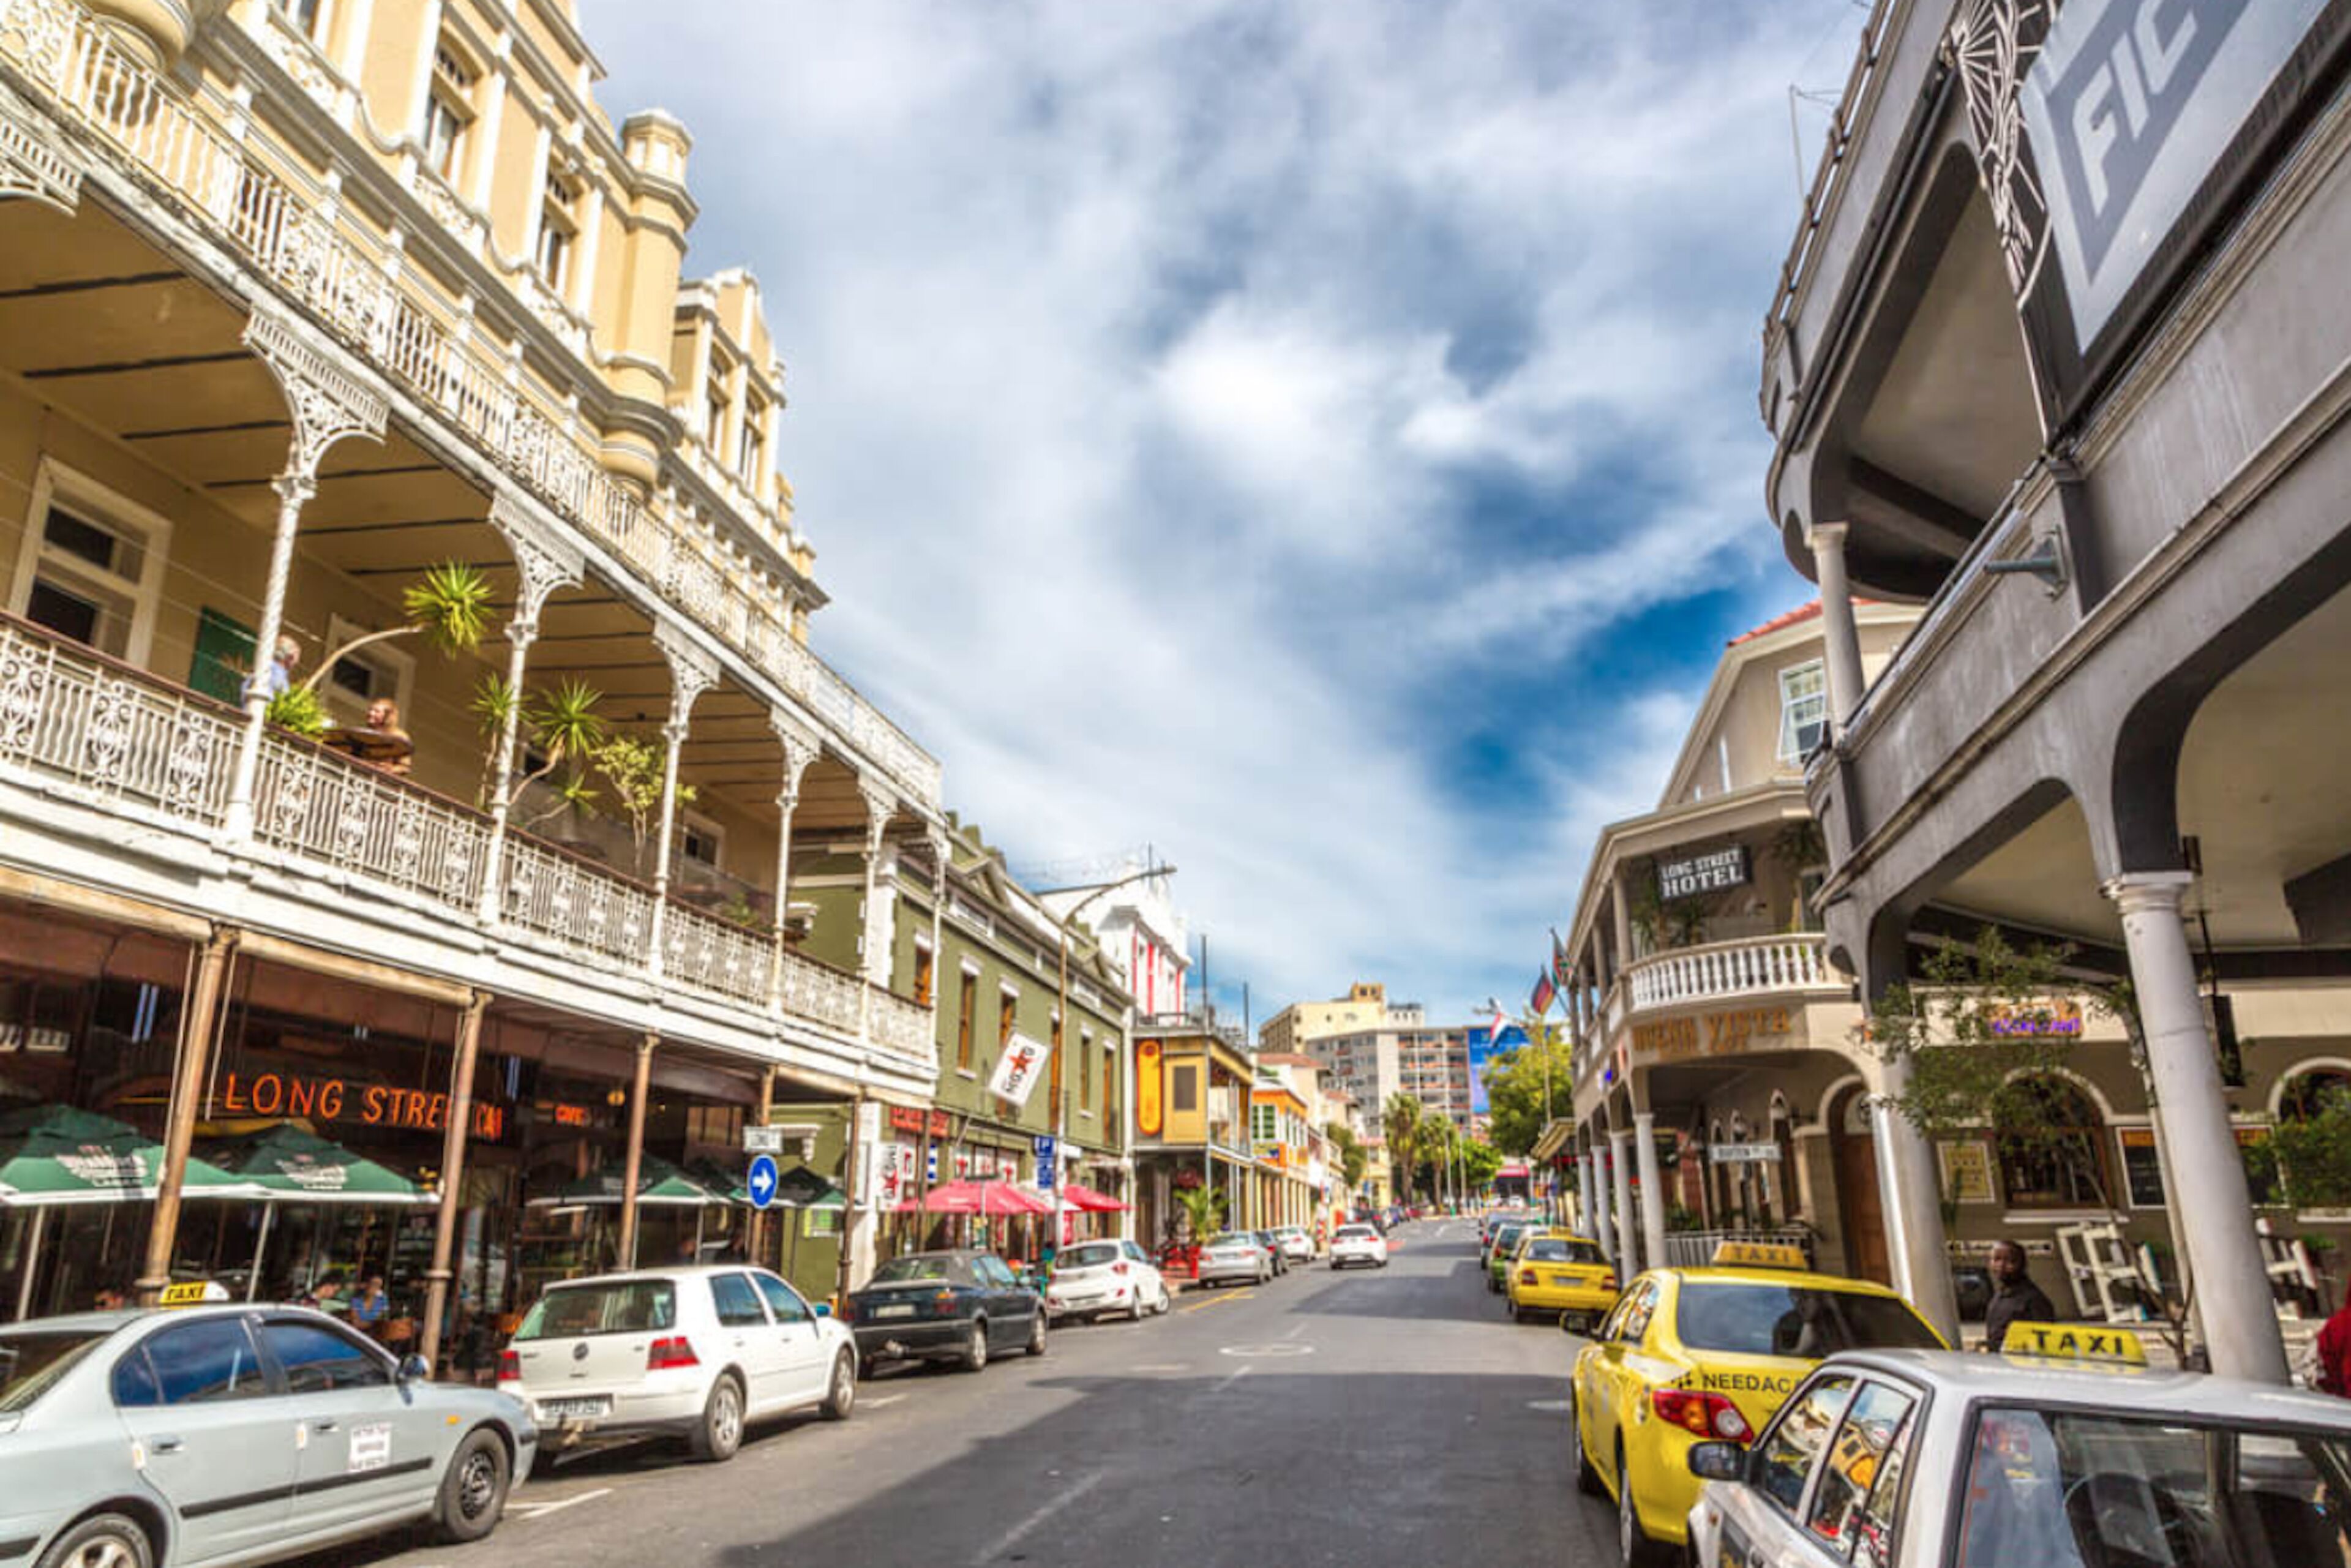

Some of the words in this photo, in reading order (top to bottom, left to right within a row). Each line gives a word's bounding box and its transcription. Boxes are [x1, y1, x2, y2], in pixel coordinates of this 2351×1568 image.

[1661, 861, 1693, 880] LONG
[1695, 848, 1740, 871] STREET
[1662, 864, 1744, 898] HOTEL
[225, 1073, 343, 1119] LONG
[1733, 1245, 1790, 1262] TAXI
[167, 1281, 206, 1300] TAXI
[2032, 1327, 2123, 1356] TAXI
